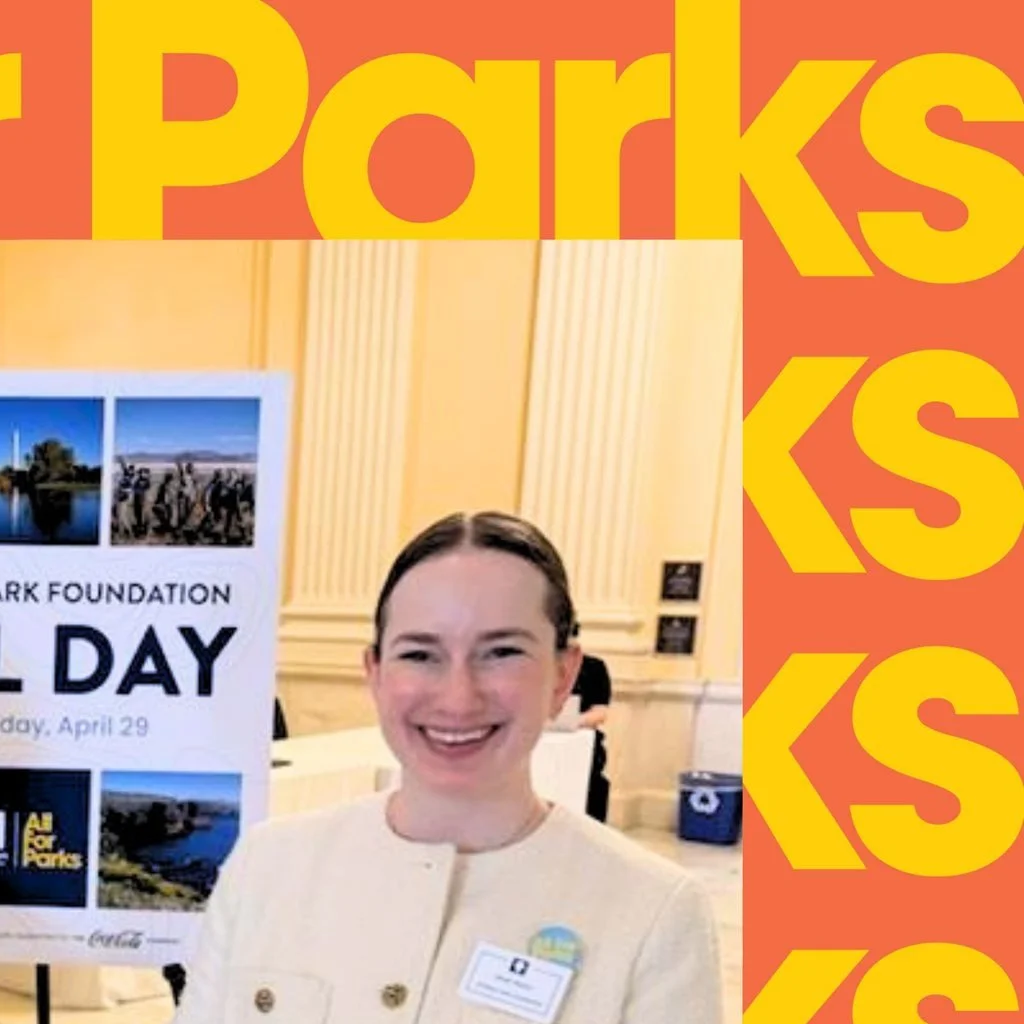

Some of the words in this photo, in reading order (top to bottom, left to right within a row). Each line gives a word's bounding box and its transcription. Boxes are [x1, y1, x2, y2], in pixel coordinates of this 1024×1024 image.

[48, 581, 231, 605] FOUNDATION
[53, 624, 238, 697] DAY
[58, 715, 113, 741] April
[120, 715, 150, 737] 29
[25, 812, 53, 833] All
[22, 849, 83, 869] Parks
